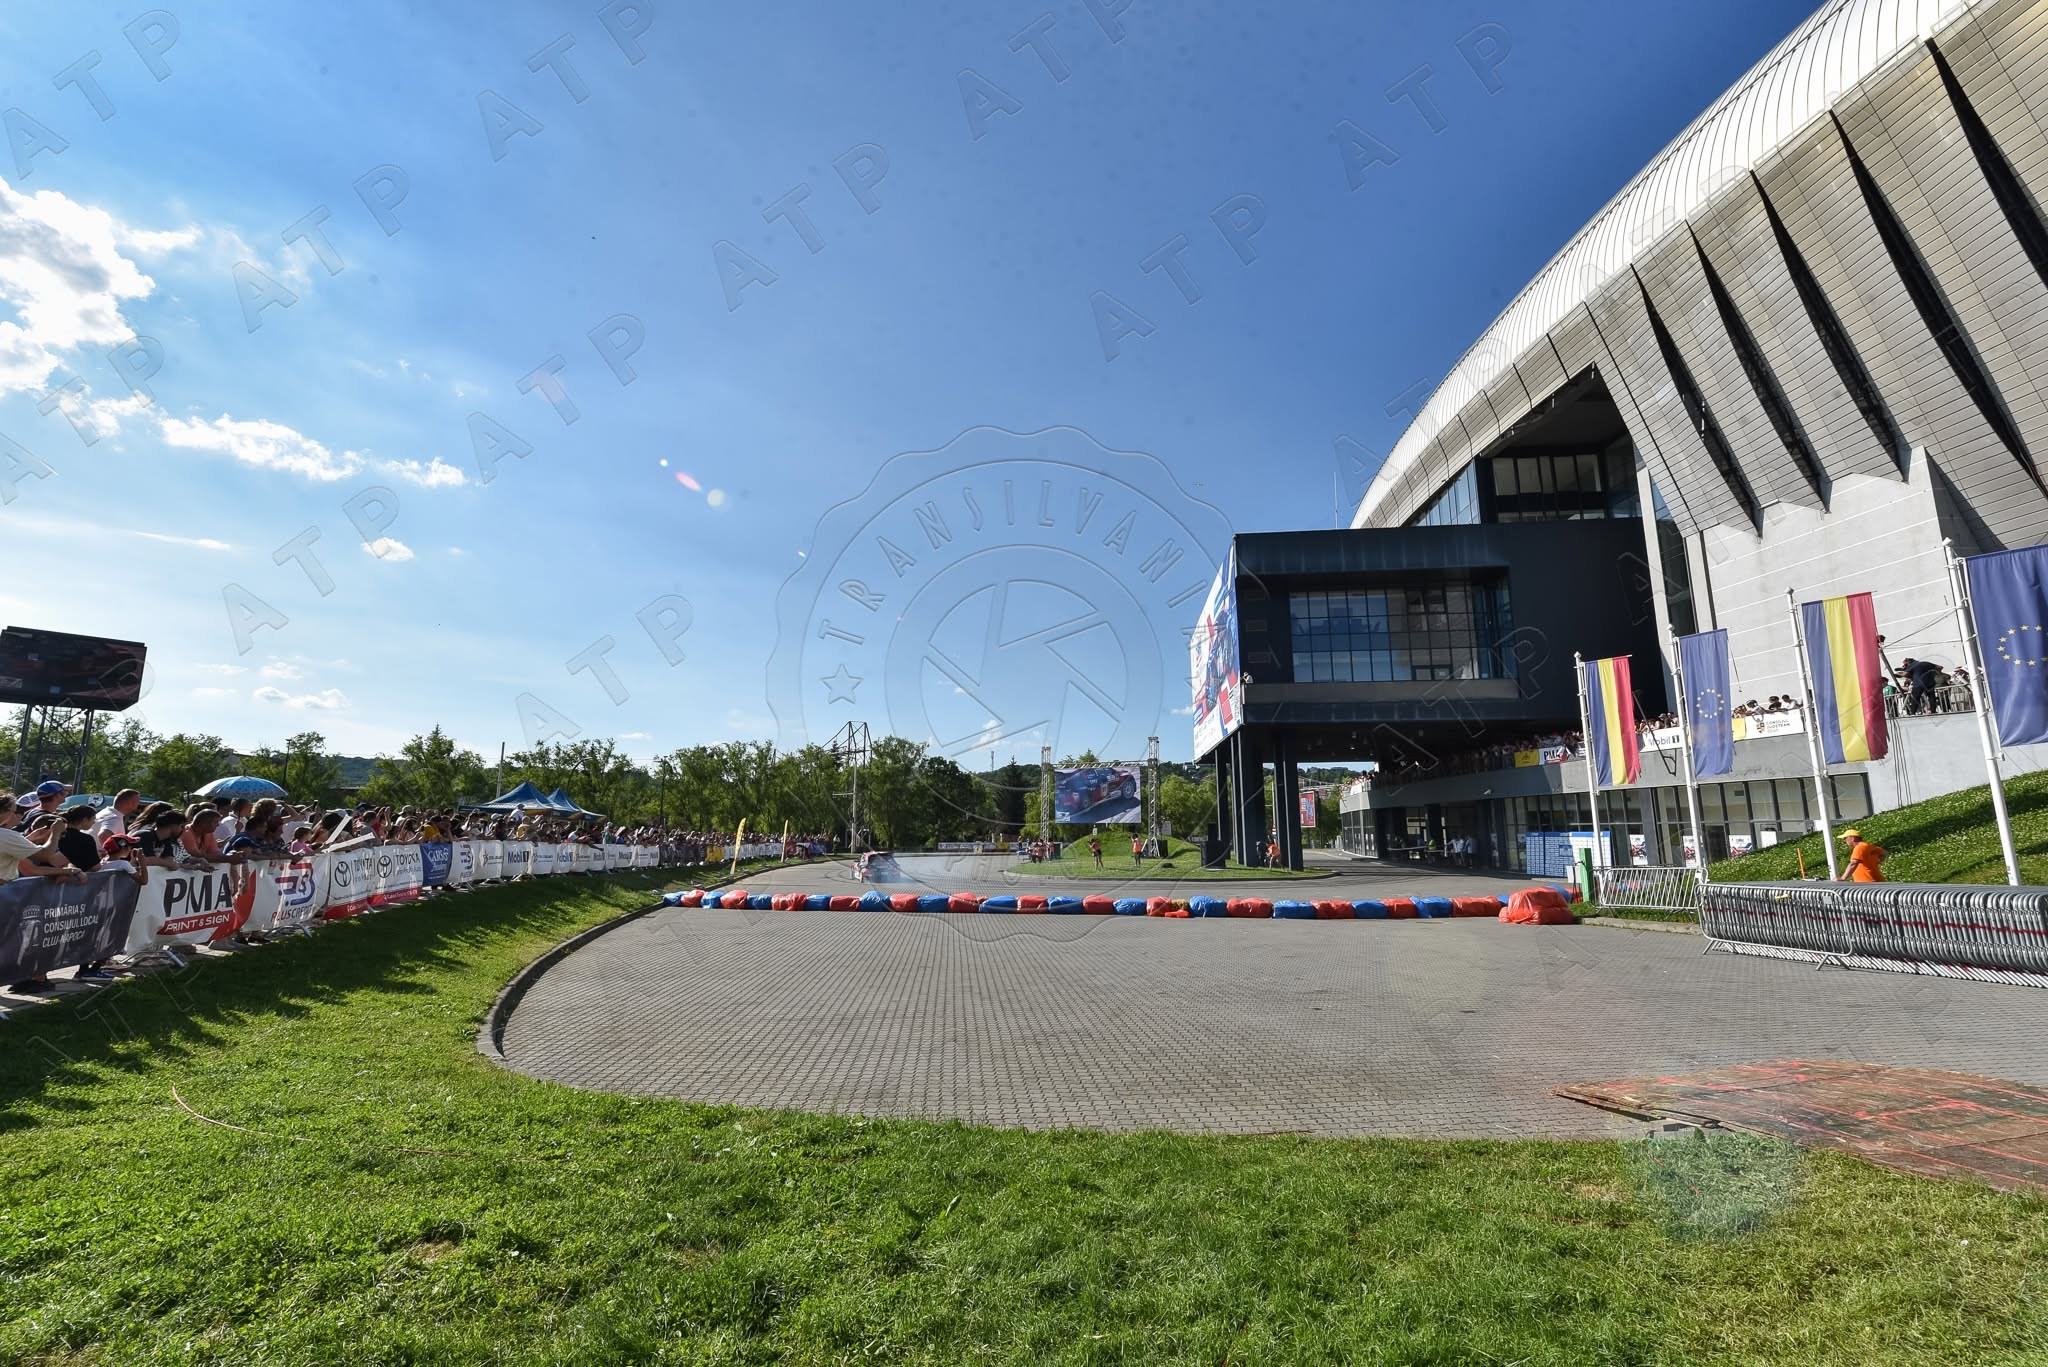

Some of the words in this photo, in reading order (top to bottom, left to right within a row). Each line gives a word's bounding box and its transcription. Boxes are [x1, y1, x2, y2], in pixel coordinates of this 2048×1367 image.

[163, 873, 233, 917] PMA
[44, 903, 79, 919] PRIMĂRIA
[80, 913, 99, 927] LOCAL
[165, 919, 197, 932] PRINT
[205, 913, 231, 927] SIGN
